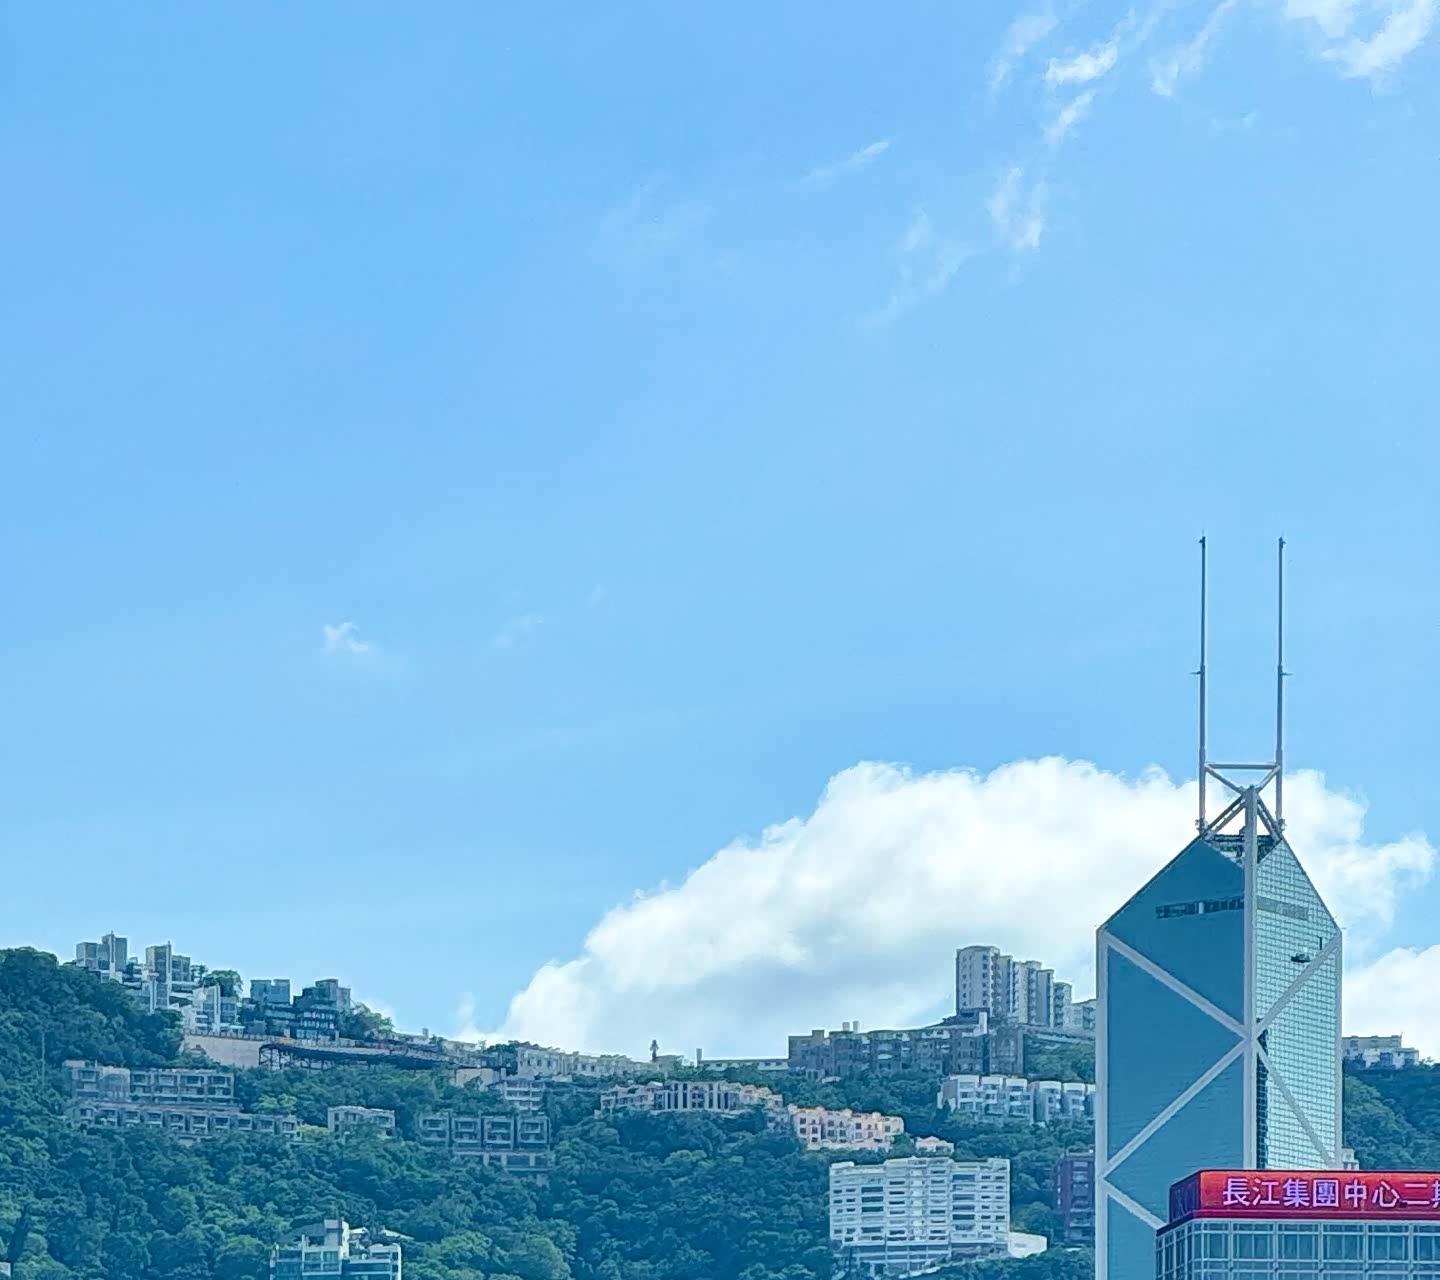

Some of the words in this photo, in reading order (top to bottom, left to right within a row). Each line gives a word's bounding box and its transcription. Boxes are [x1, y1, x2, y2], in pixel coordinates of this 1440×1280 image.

[1222, 1178, 1440, 1209] 長江集團中心二
